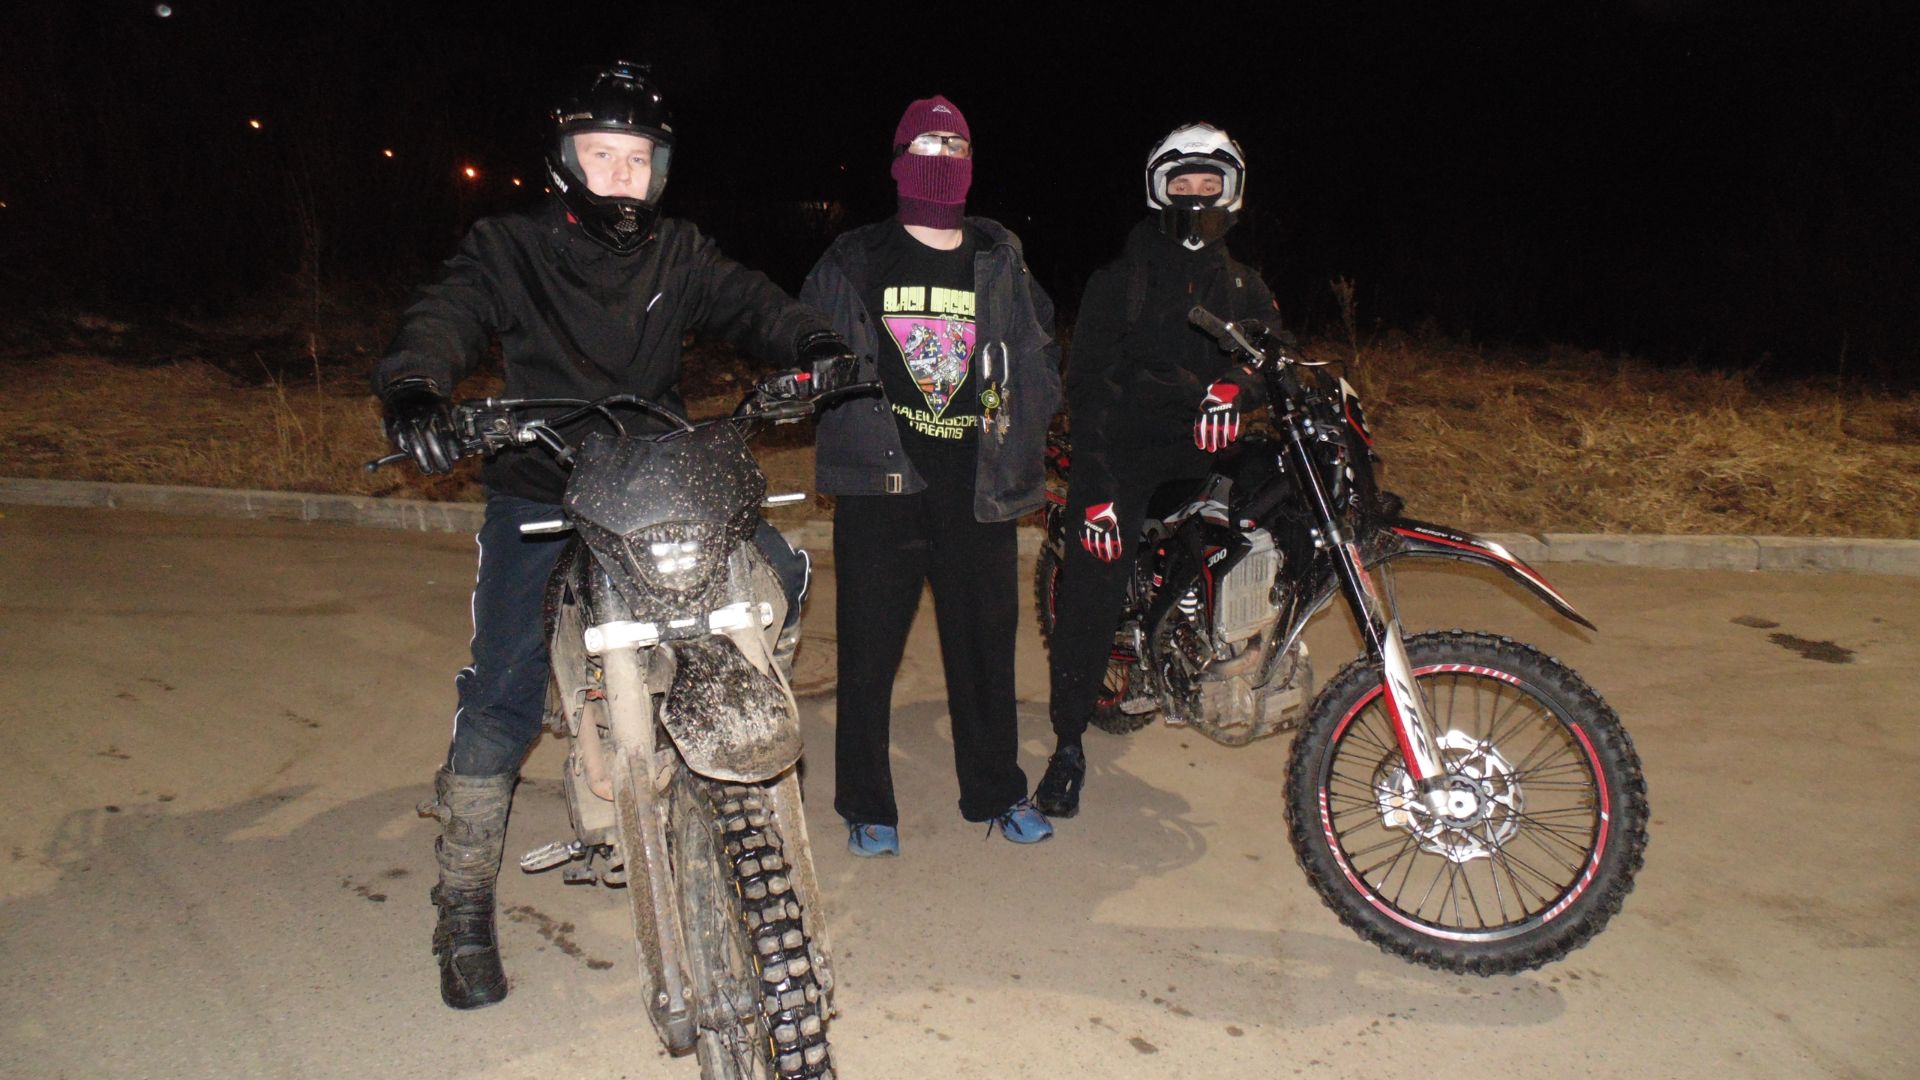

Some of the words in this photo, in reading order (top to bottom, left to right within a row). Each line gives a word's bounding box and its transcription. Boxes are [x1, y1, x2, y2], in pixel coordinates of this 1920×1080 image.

[1208, 403, 1232, 413] THOR
[1084, 520, 1104, 533] THOR
[1207, 548, 1227, 568] 300
